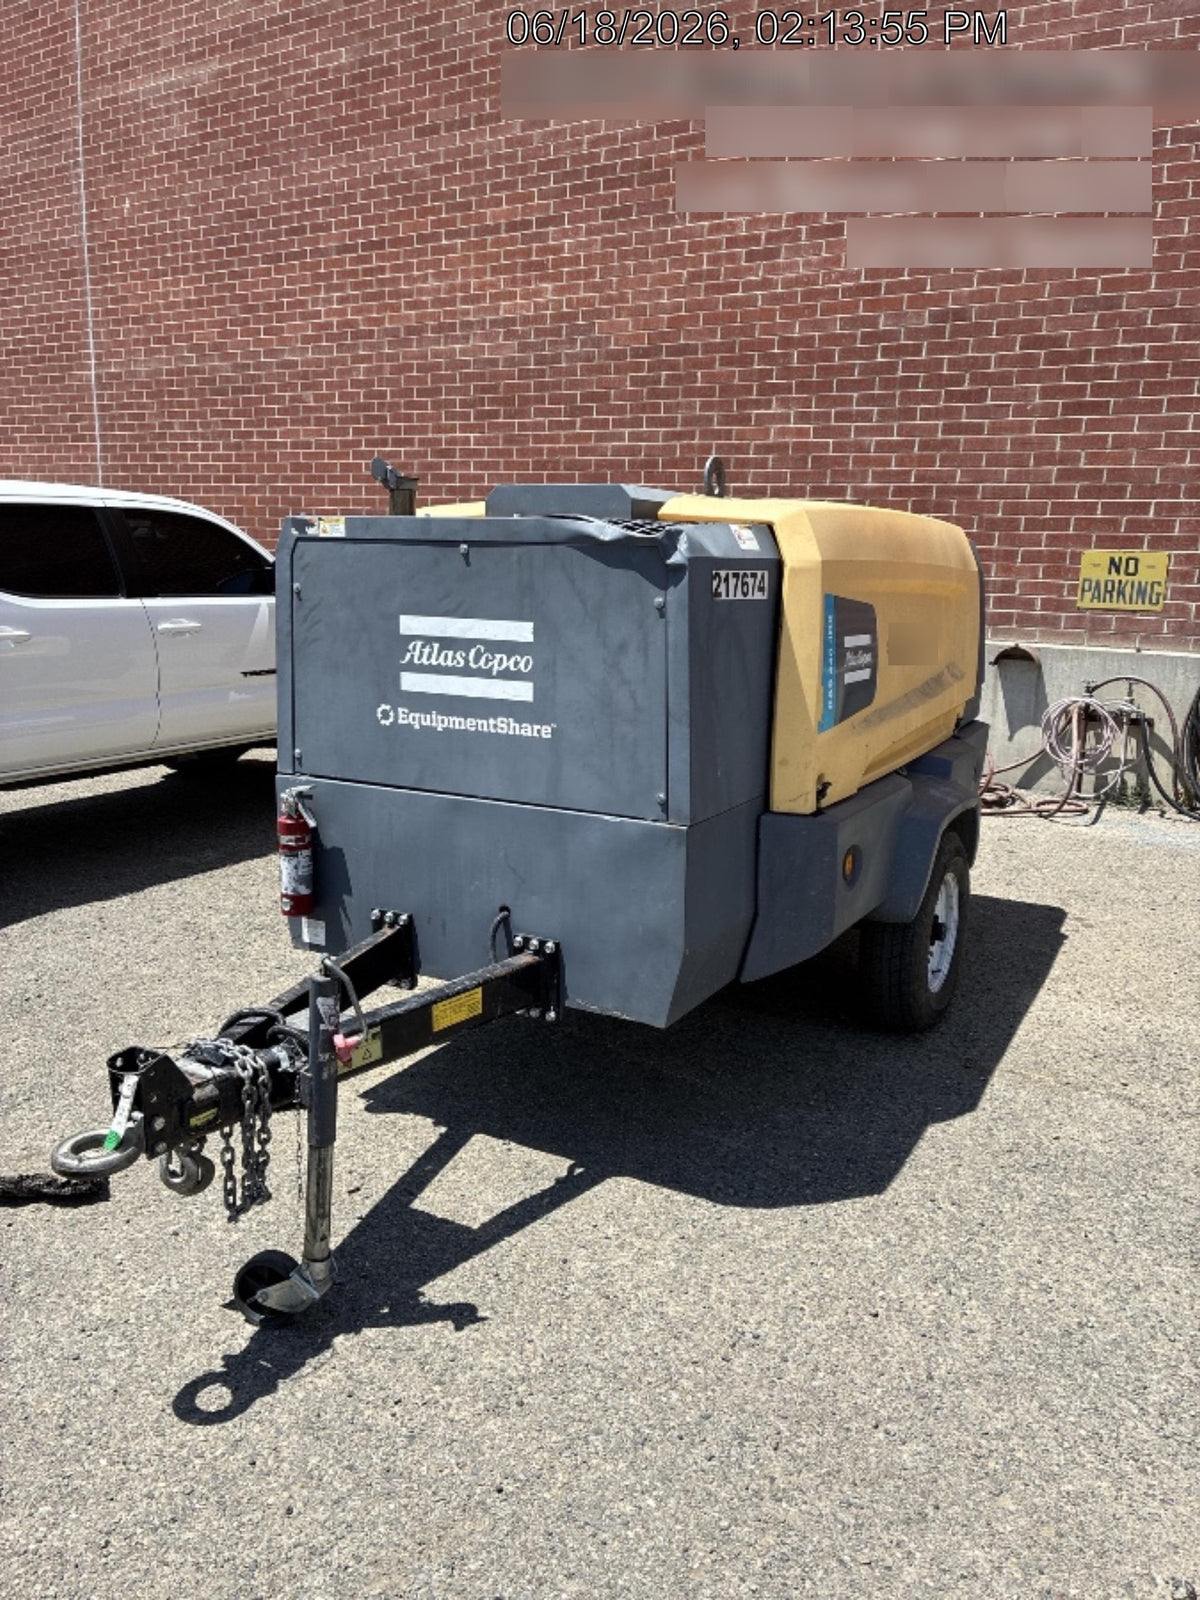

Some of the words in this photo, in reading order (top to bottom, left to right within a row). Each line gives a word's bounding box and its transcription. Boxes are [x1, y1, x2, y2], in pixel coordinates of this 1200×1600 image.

[1107, 555, 1140, 577] NO
[712, 571, 765, 598] 217674
[1080, 577, 1163, 606] PARKING
[400, 639, 466, 668] Atlas
[468, 644, 534, 676] Copco
